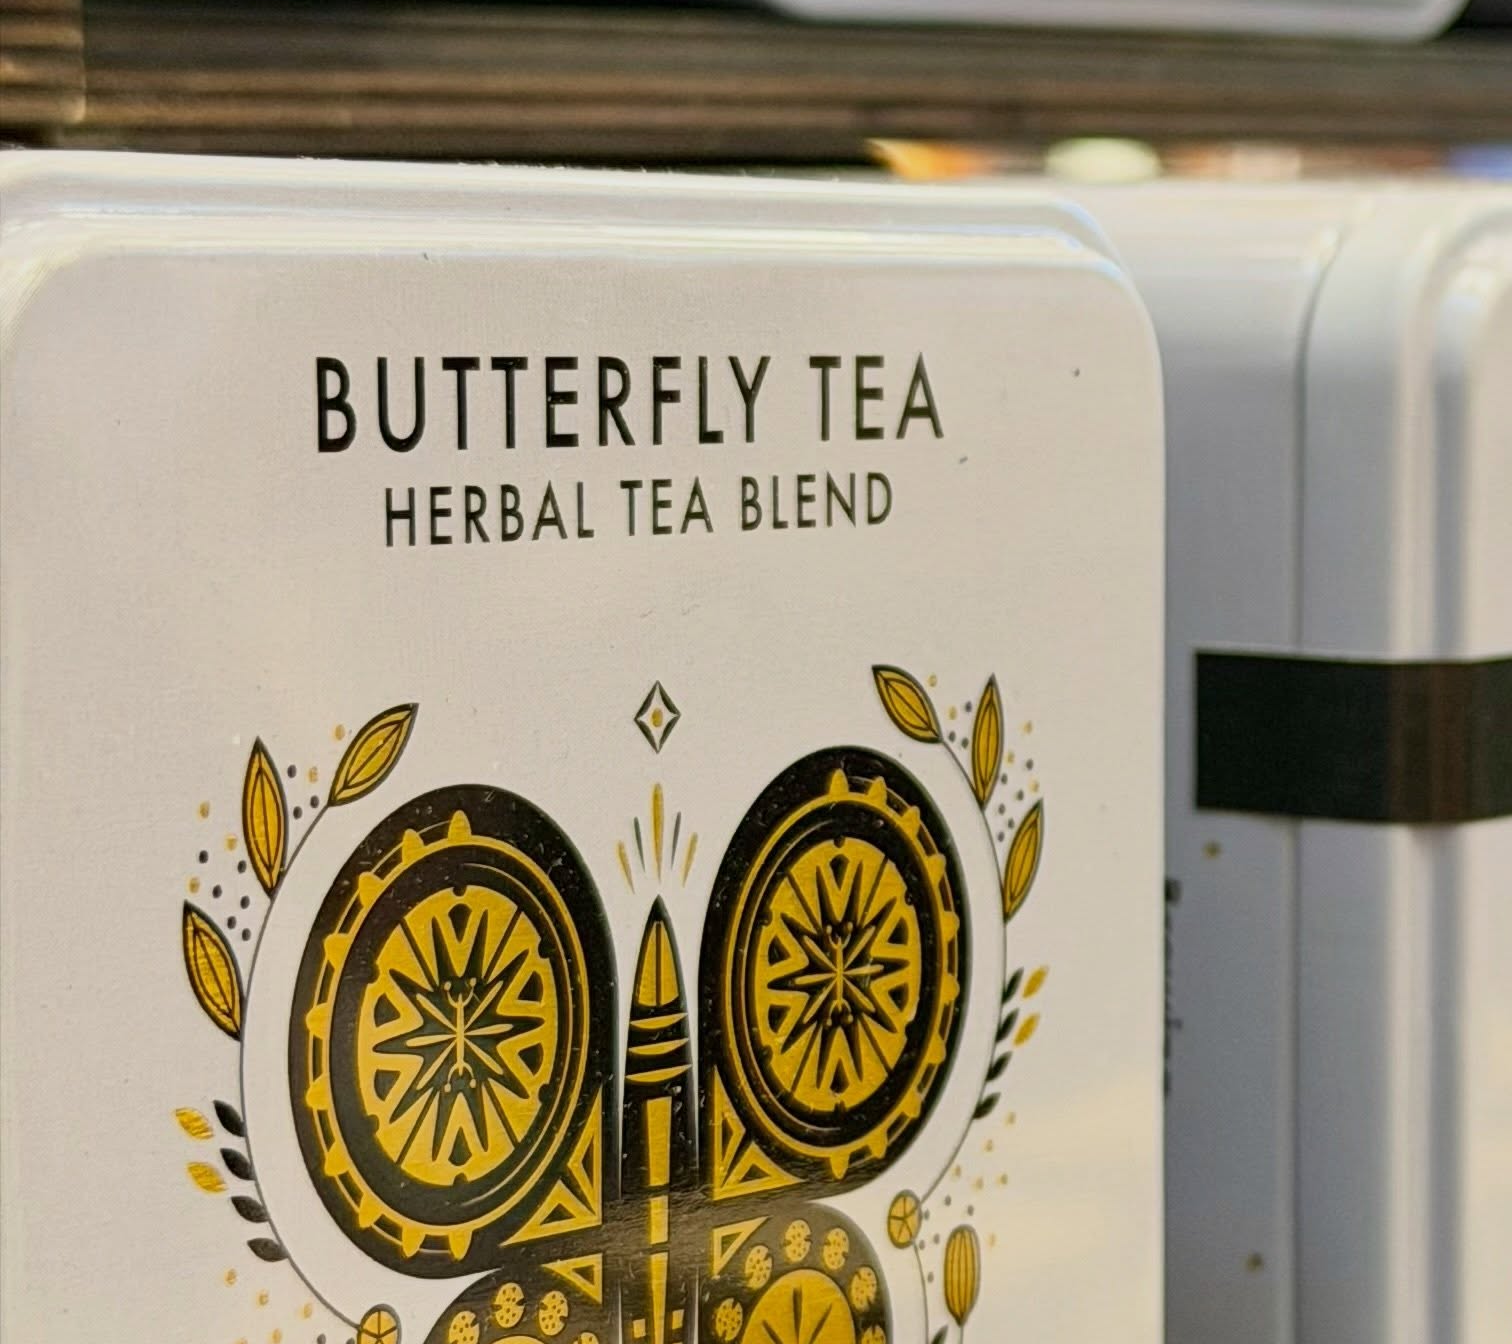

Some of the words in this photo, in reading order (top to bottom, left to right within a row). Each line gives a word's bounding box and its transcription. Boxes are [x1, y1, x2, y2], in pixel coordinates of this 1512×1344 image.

[316, 355, 771, 454] BUTTERFLY
[809, 351, 945, 442] TEA
[385, 481, 595, 547] HERBAL
[619, 476, 715, 536] TEA
[739, 471, 894, 531] BLEND
